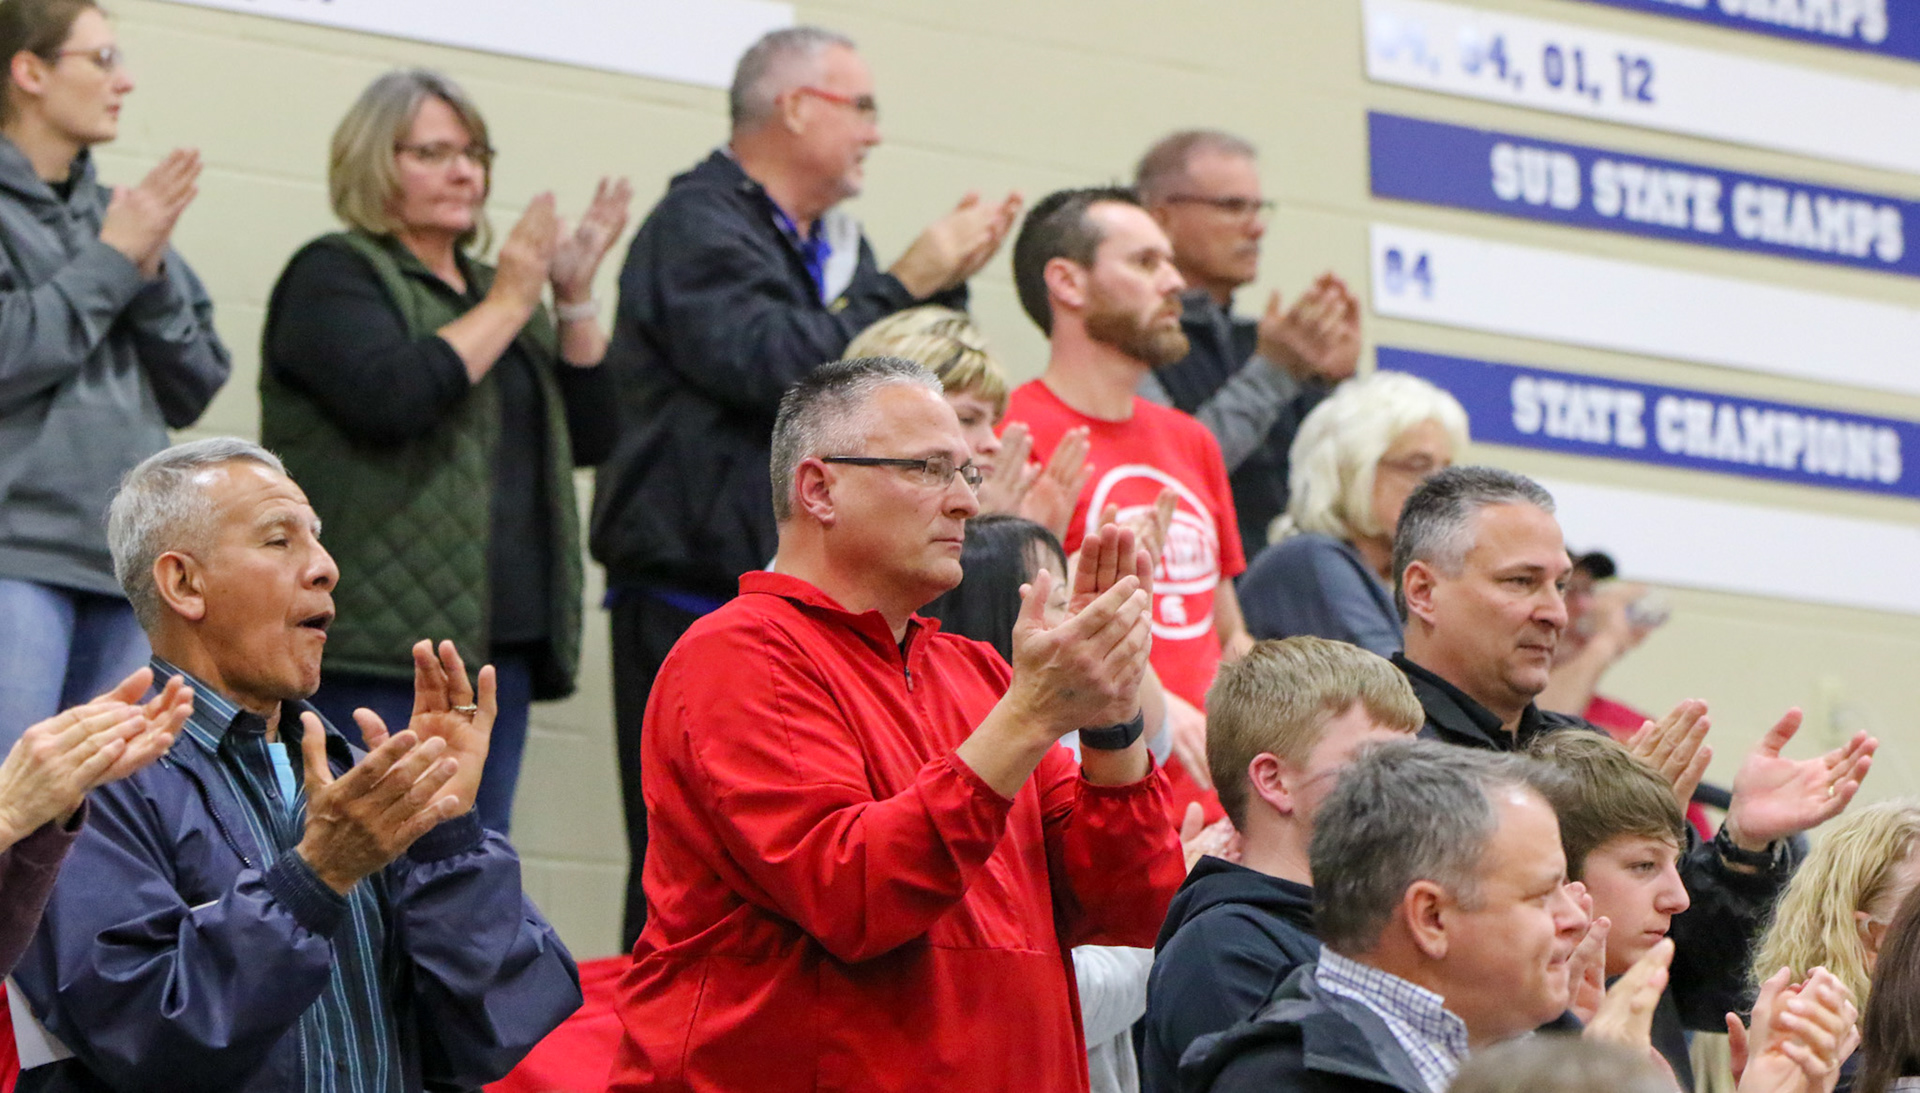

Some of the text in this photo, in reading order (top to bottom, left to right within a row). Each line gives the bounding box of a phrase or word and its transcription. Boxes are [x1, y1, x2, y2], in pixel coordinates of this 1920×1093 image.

[1719, 0, 1888, 43] MPS
[1615, 51, 1656, 102] 12
[1490, 143, 1904, 263] SUB STATE CHAMPS
[1511, 376, 1902, 484] STATE CHAMPIONS
